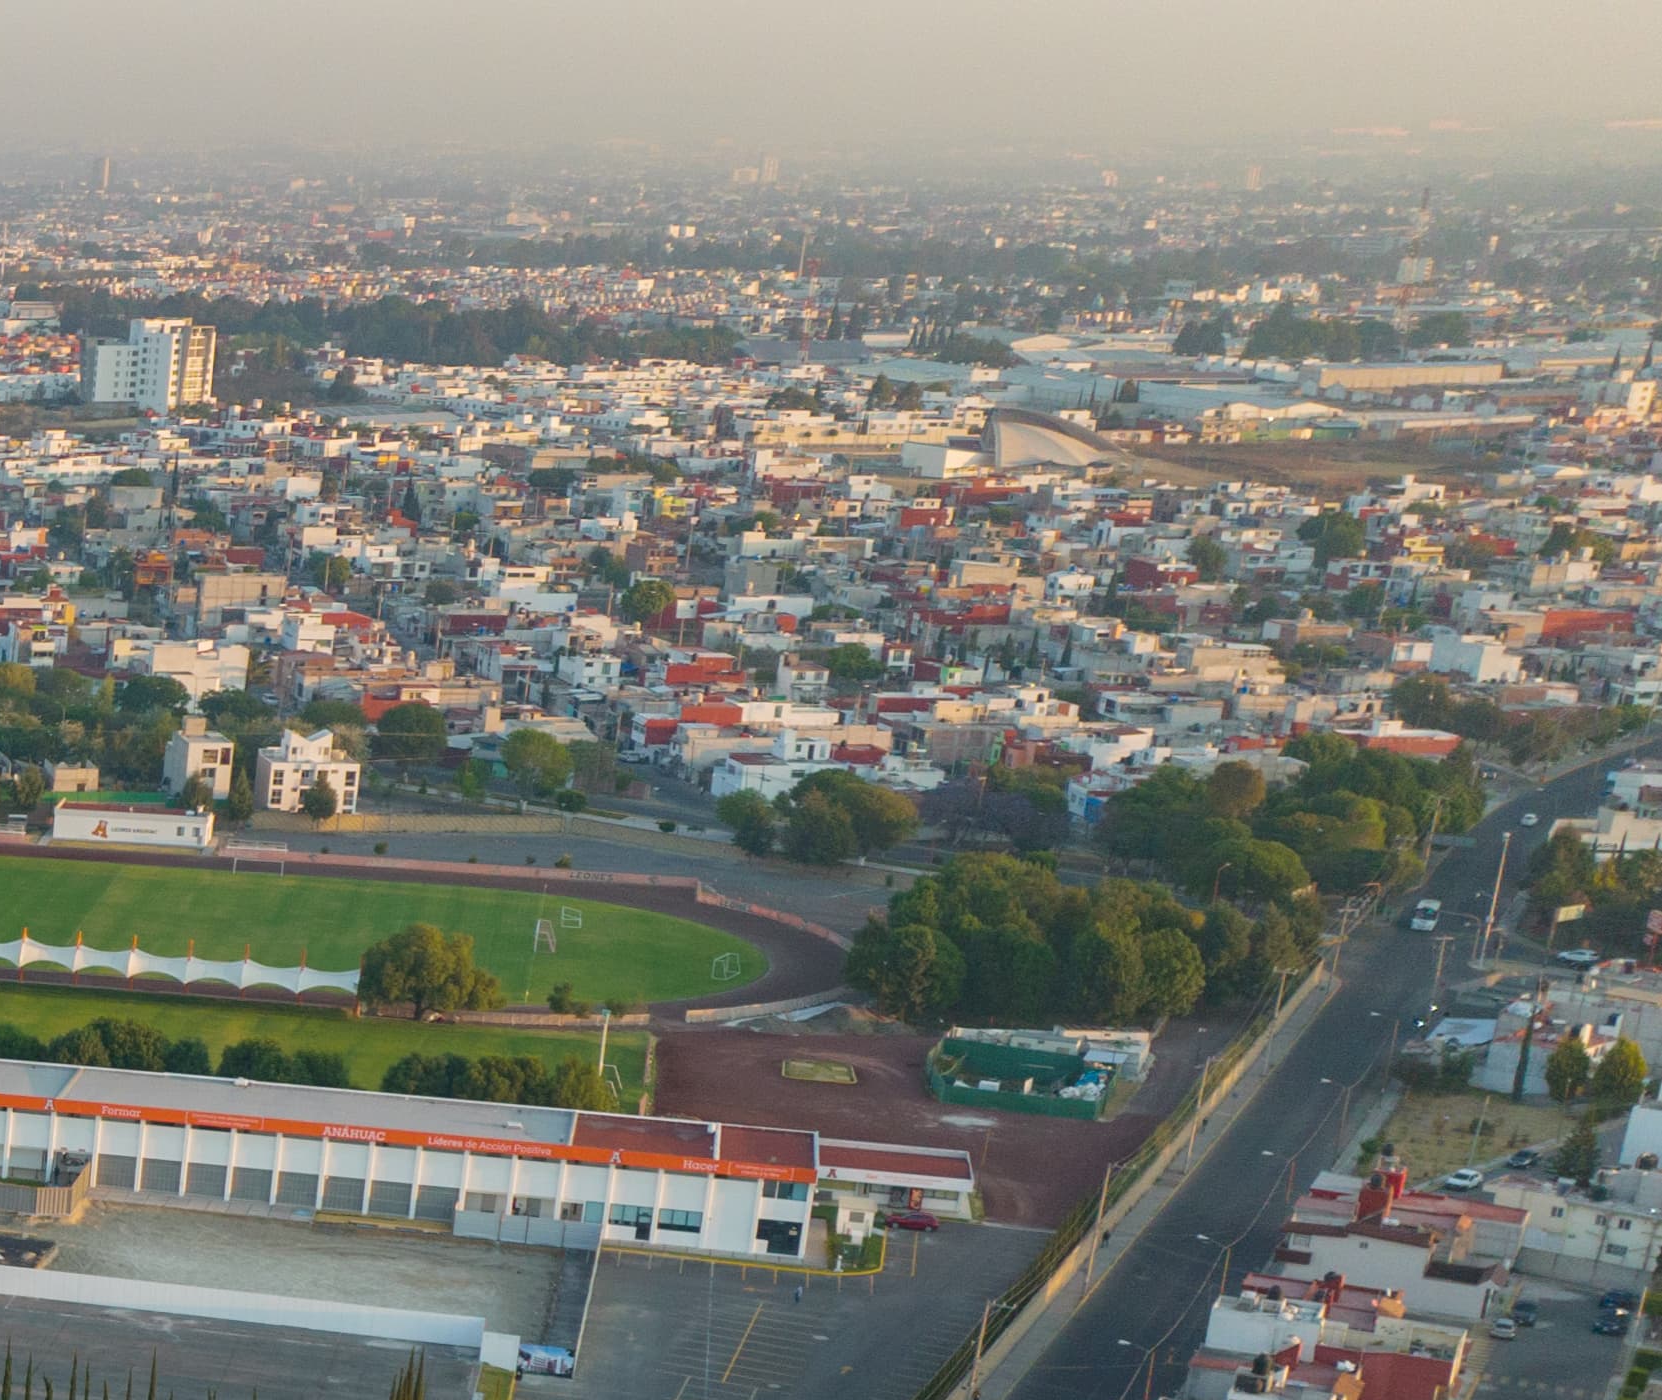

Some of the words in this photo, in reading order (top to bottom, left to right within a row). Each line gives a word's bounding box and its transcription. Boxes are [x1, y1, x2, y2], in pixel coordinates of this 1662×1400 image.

[101, 1104, 142, 1118] Formar
[322, 1125, 386, 1142] ANÁHUAC
[427, 1136, 463, 1148] Líderes
[479, 1140, 512, 1152] Acción
[514, 1143, 552, 1156] Positiva
[682, 1158, 720, 1172] Hacer
